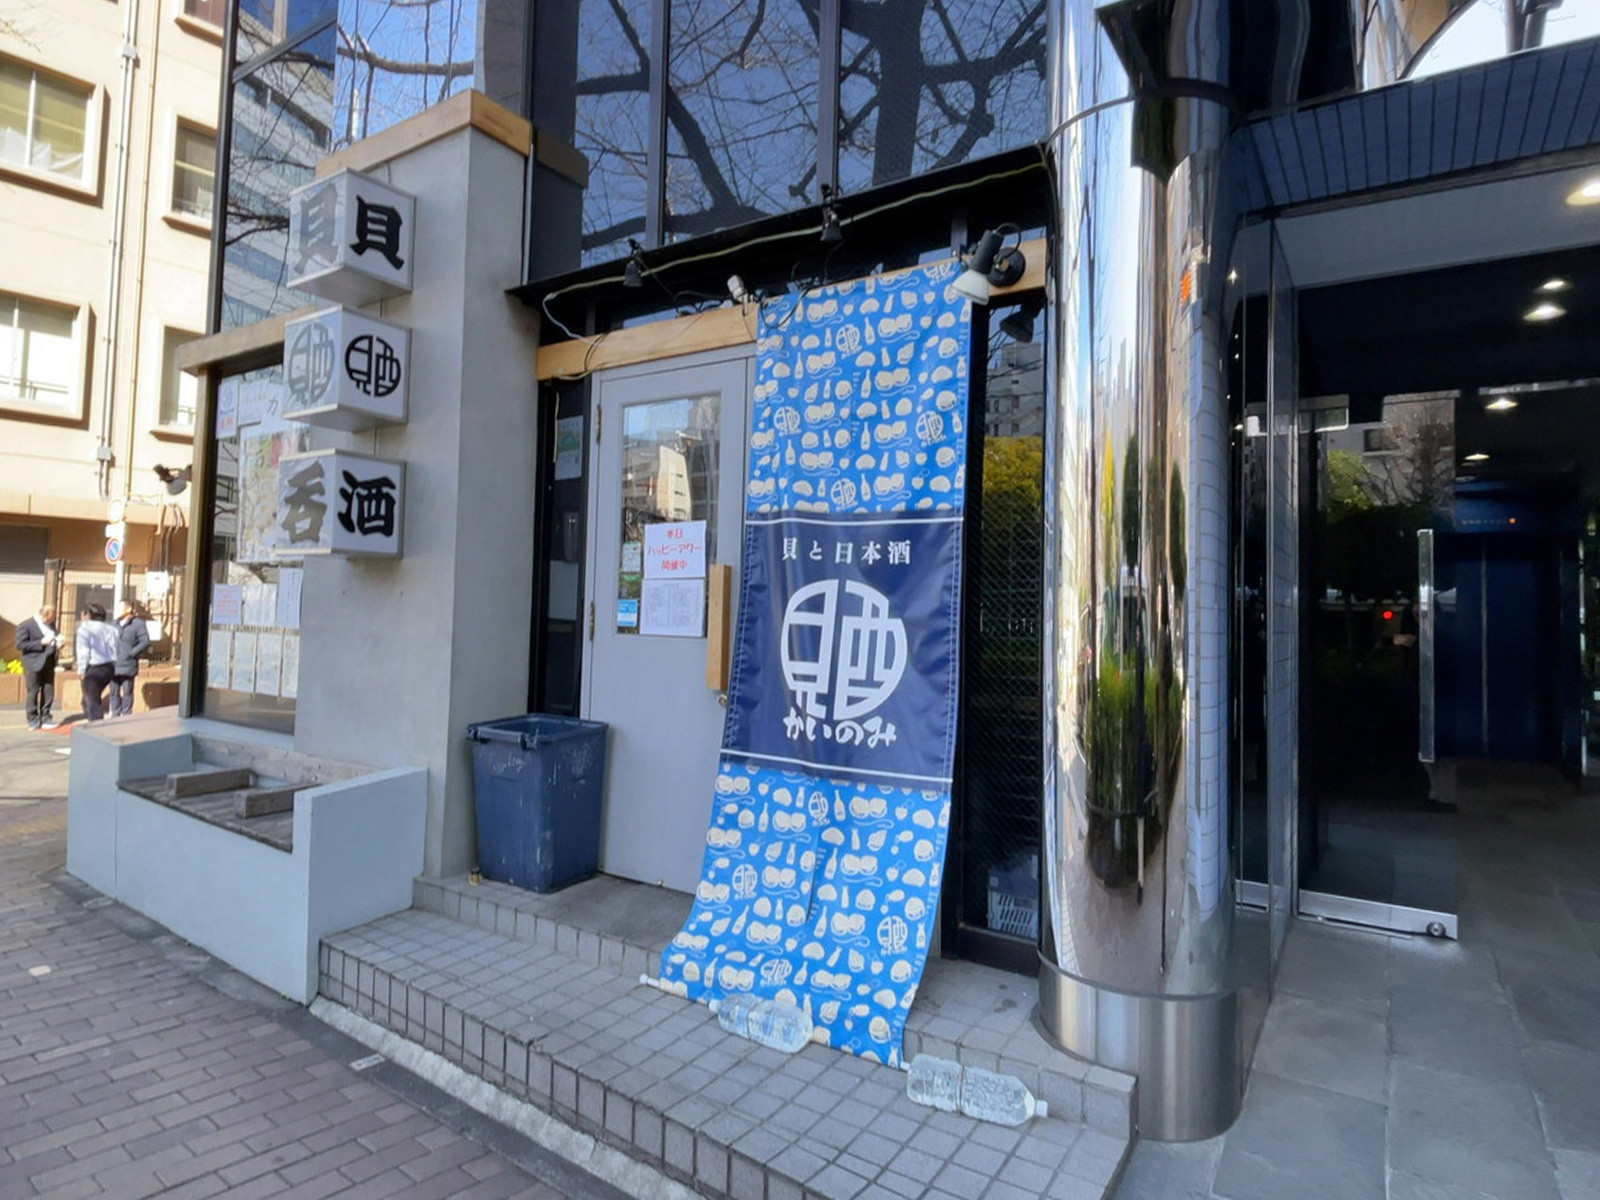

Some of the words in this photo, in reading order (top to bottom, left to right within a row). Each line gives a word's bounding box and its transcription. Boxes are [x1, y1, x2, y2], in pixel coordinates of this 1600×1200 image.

[293, 183, 339, 274] 貝
[349, 195, 405, 271] 貝
[337, 470, 397, 538] 酒
[782, 537, 911, 565] 貝と日本酒
[782, 706, 897, 748] かいのみ
